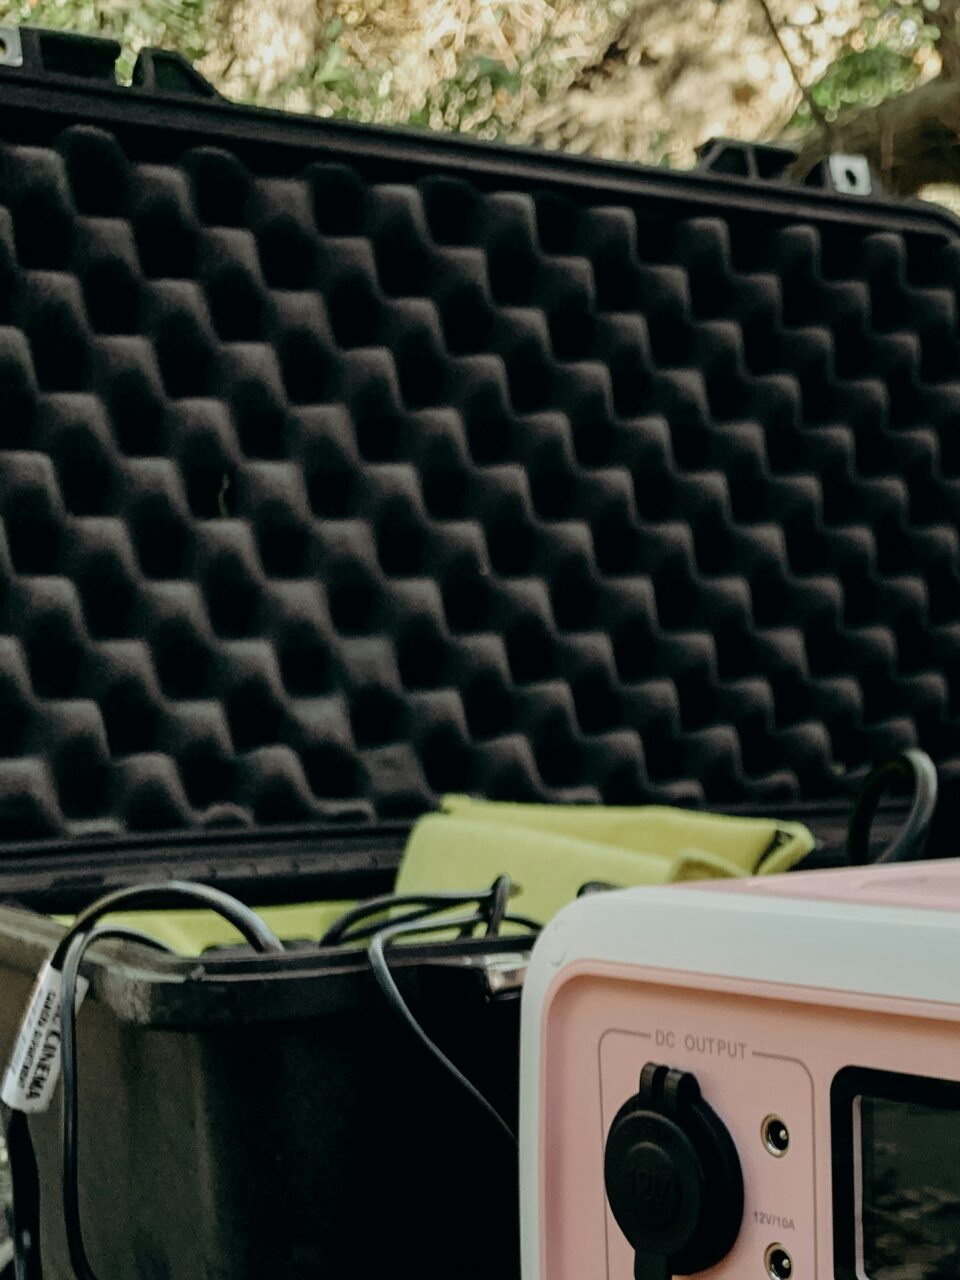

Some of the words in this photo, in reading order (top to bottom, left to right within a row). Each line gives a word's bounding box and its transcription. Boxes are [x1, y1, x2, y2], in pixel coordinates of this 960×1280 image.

[655, 1030, 676, 1048] DC
[684, 1037, 747, 1059] OUTPUT
[753, 1211, 796, 1231] 12V/10A
